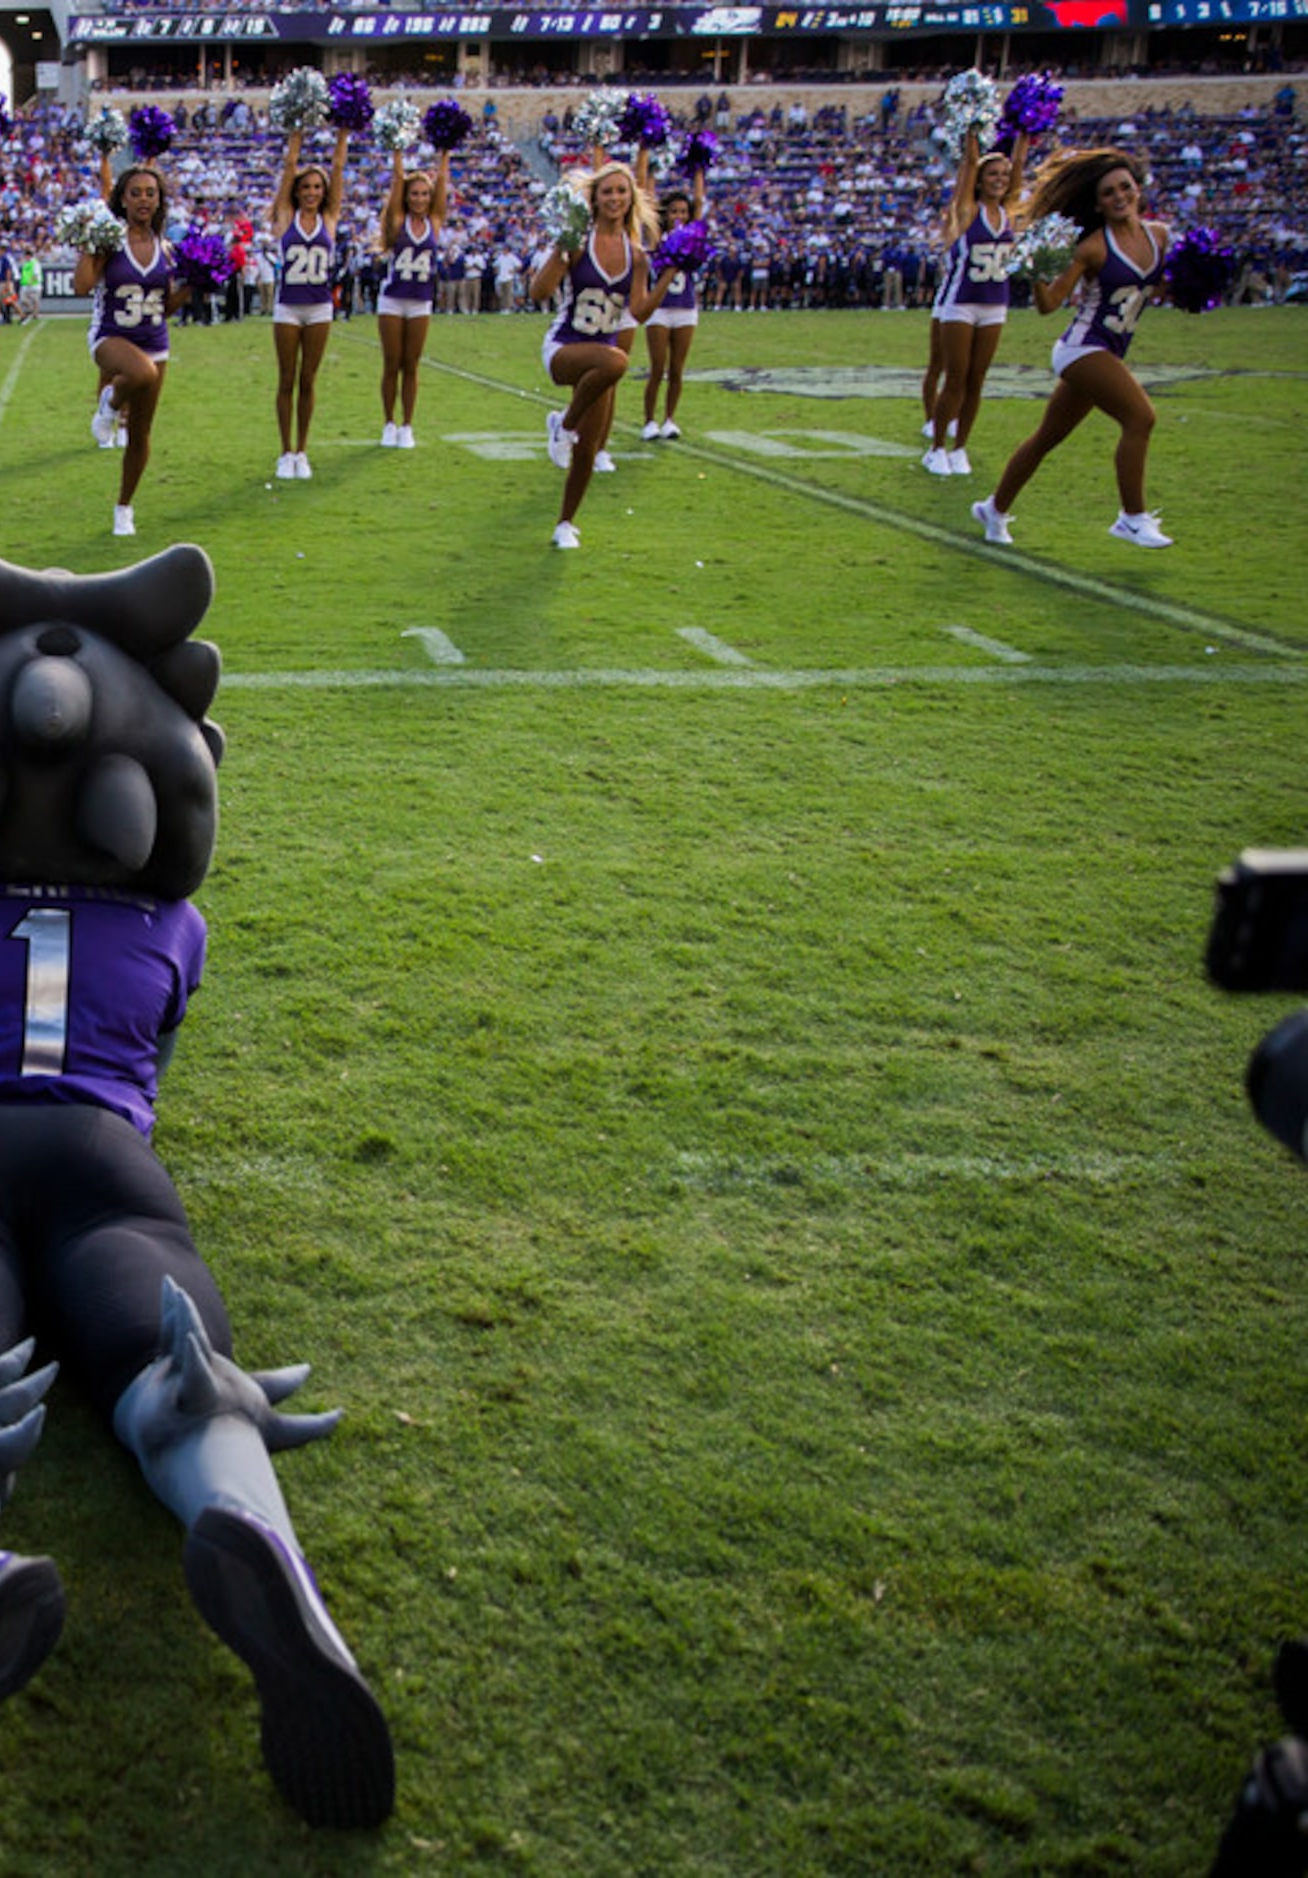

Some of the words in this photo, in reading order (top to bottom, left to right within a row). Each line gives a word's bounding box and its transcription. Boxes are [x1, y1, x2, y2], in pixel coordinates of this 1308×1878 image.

[285, 244, 329, 285] 20
[394, 246, 432, 283] 44
[113, 284, 166, 328] 34
[10, 907, 71, 1077] 1
